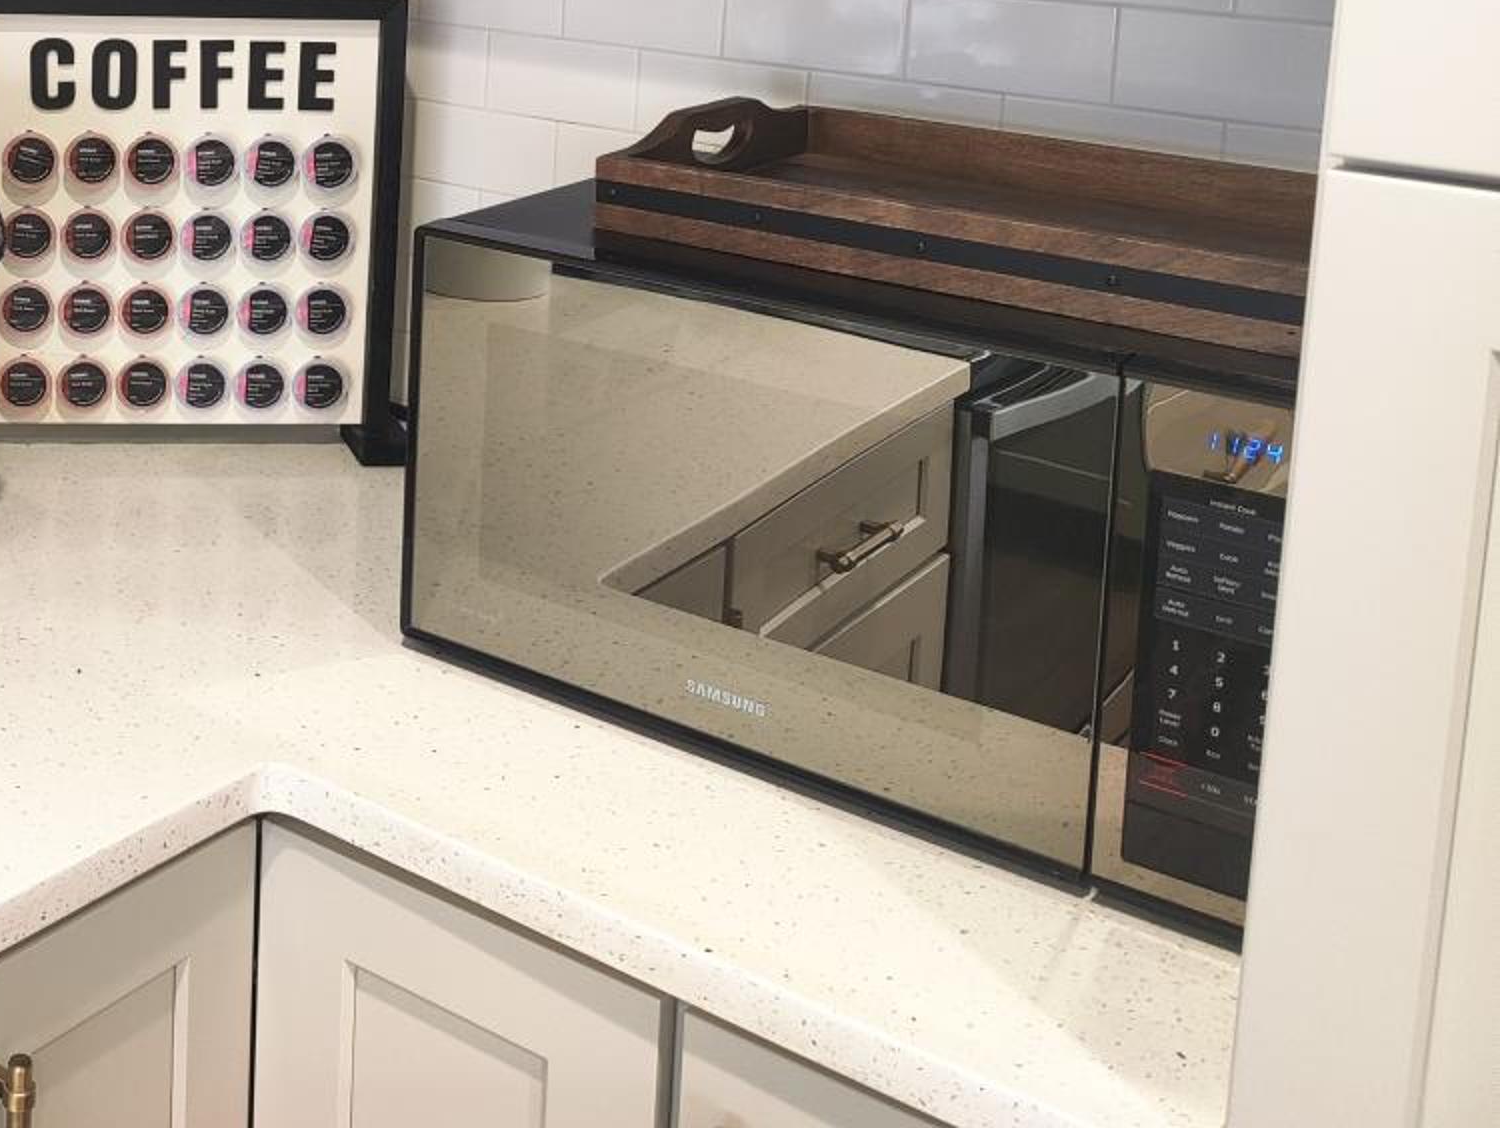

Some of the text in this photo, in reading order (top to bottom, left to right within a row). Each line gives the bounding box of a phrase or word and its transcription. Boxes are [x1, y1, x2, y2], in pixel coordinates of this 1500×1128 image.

[30, 38, 336, 112] COFFEE
[1172, 639, 1180, 651] 1
[1216, 651, 1226, 663] 2
[1169, 665, 1179, 675] 4
[1215, 676, 1224, 688] 5
[685, 679, 766, 717] SAMSUNG
[1212, 701, 1221, 713] 8
